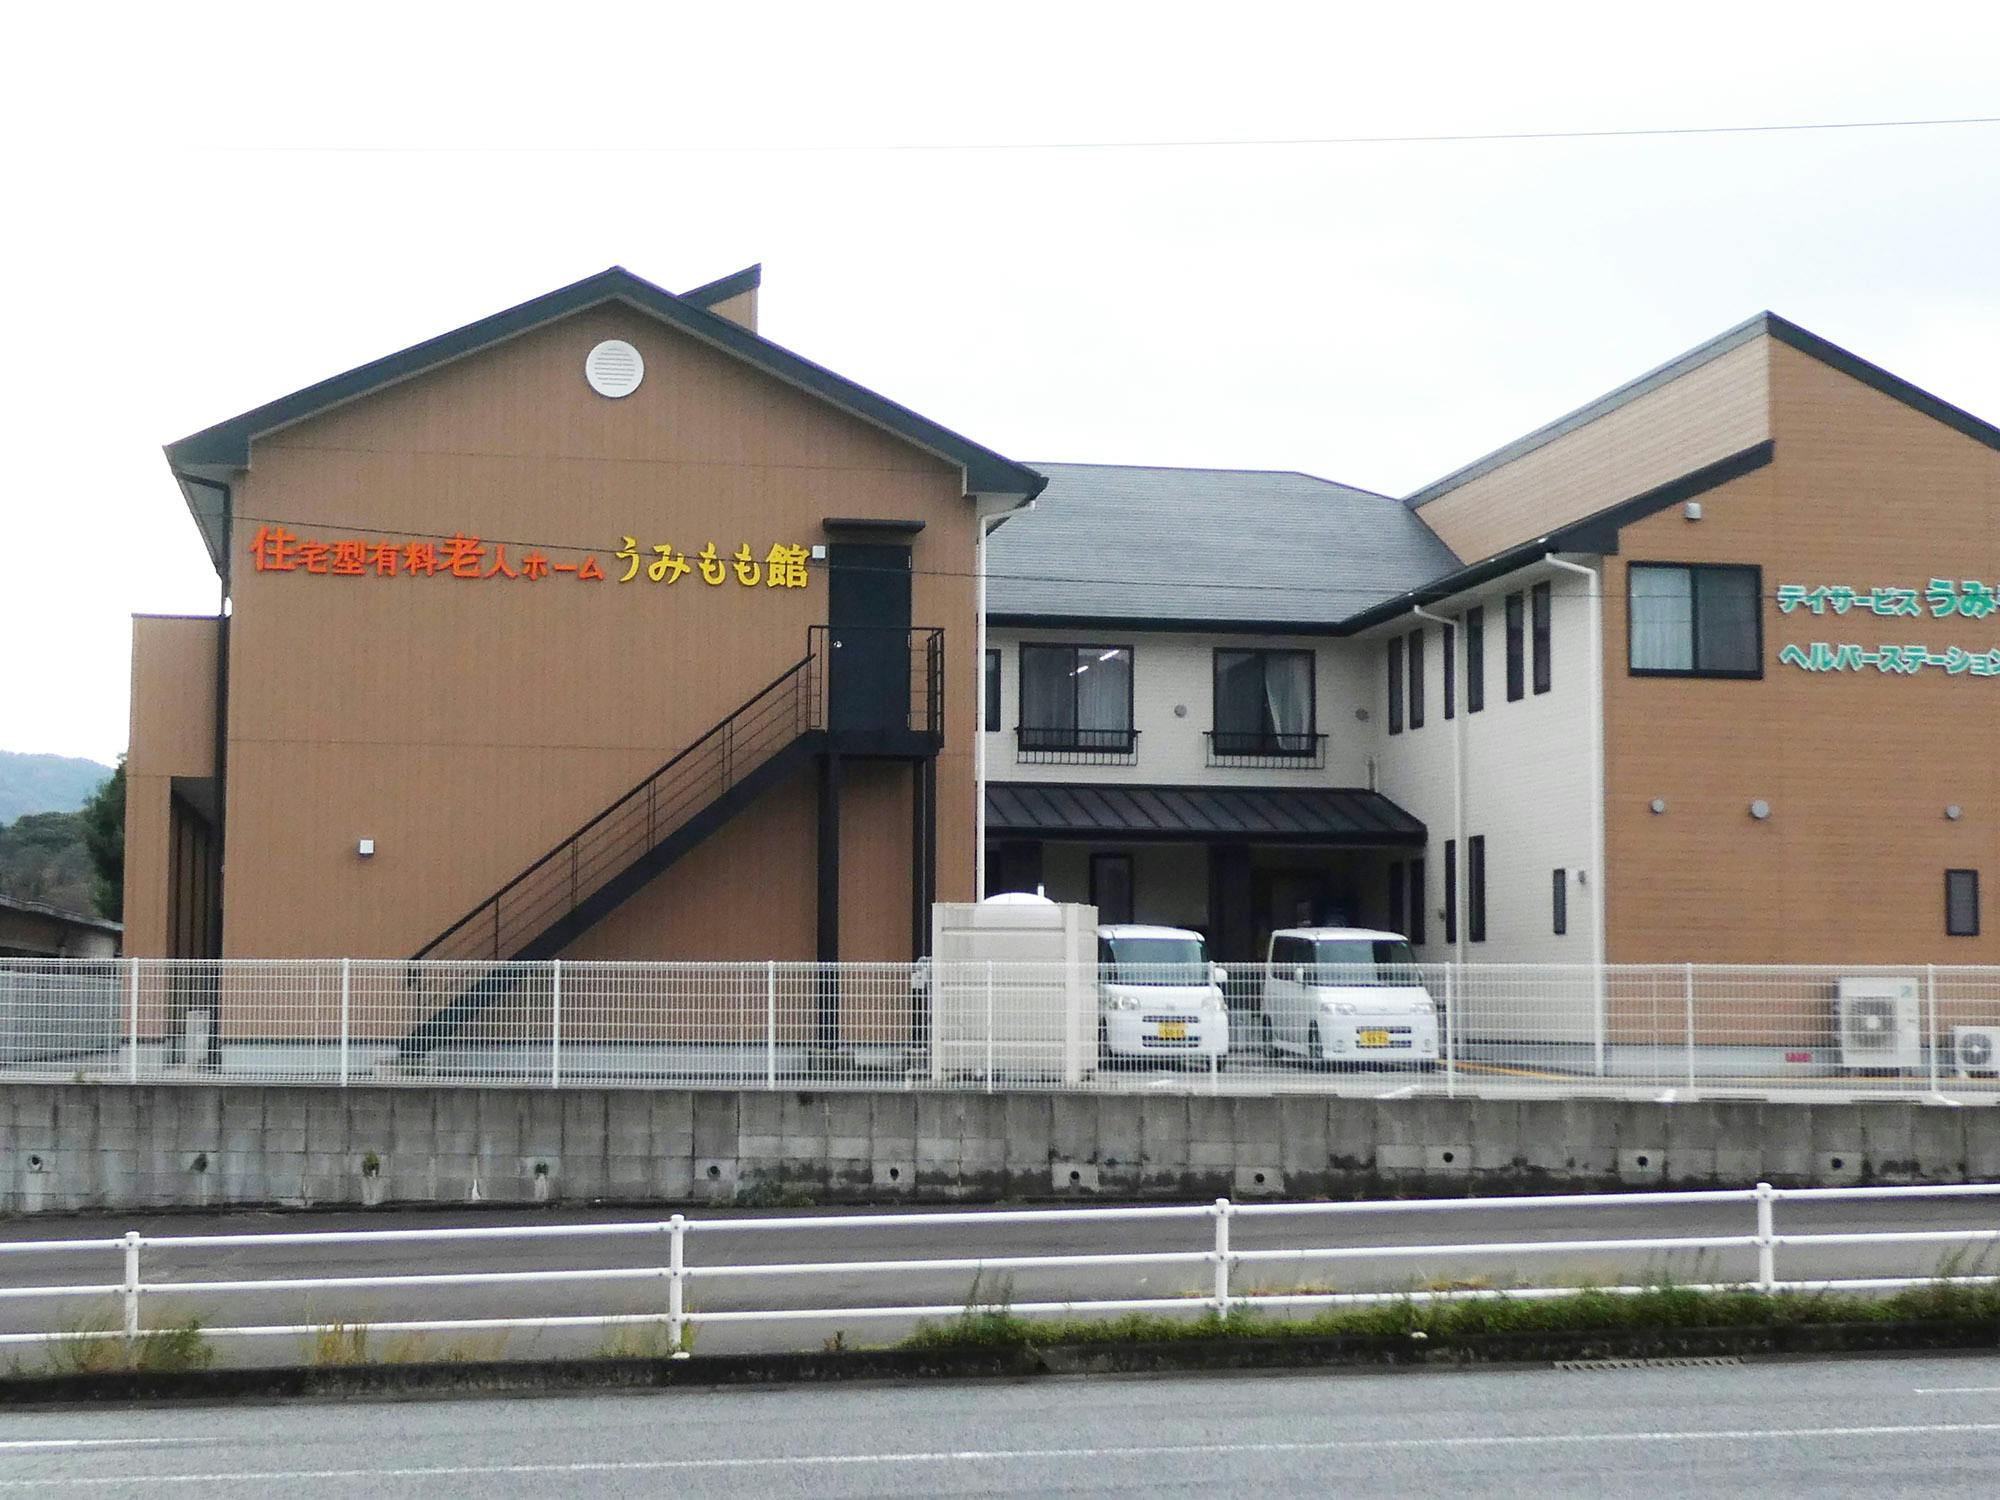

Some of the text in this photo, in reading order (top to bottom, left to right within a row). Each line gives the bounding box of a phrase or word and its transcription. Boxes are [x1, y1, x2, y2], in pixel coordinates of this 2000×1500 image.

[250, 525, 810, 588] 住宅型有料老人ホーム うみもも館
[1925, 578, 2000, 619] うみ
